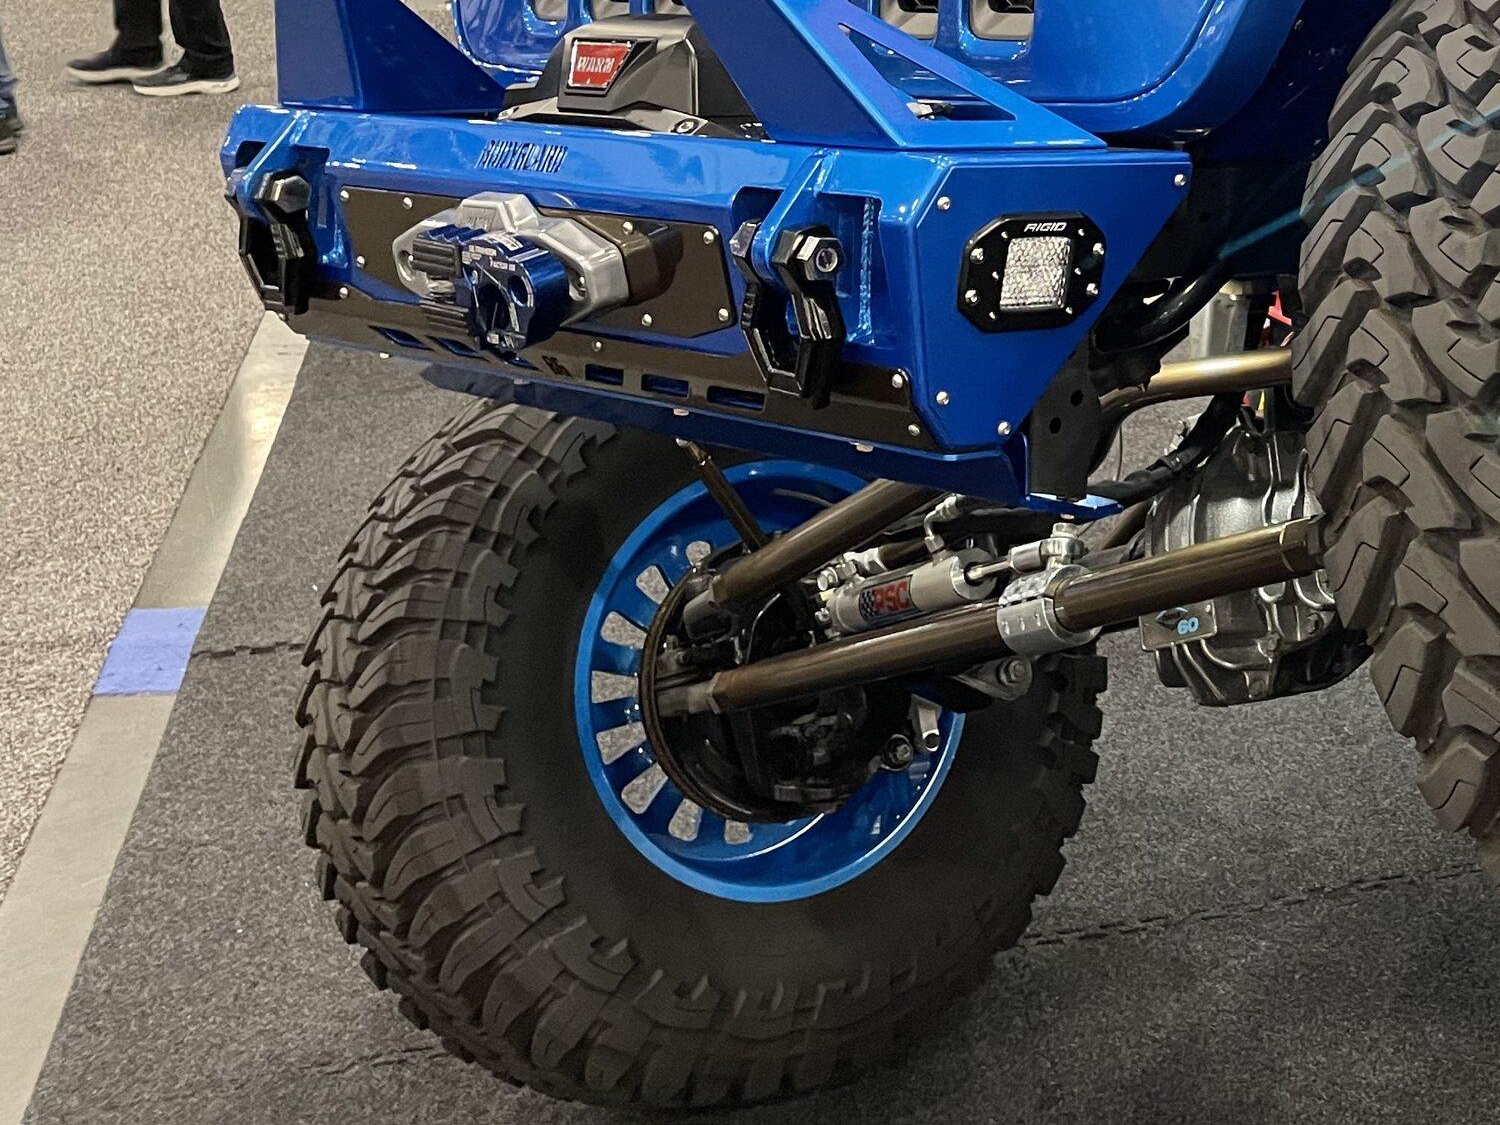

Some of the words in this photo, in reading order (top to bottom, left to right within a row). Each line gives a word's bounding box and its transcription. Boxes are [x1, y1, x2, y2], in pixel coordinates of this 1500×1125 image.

[576, 55, 616, 74] WARN
[1023, 221, 1068, 233] RIGID
[1176, 616, 1199, 635] 60
